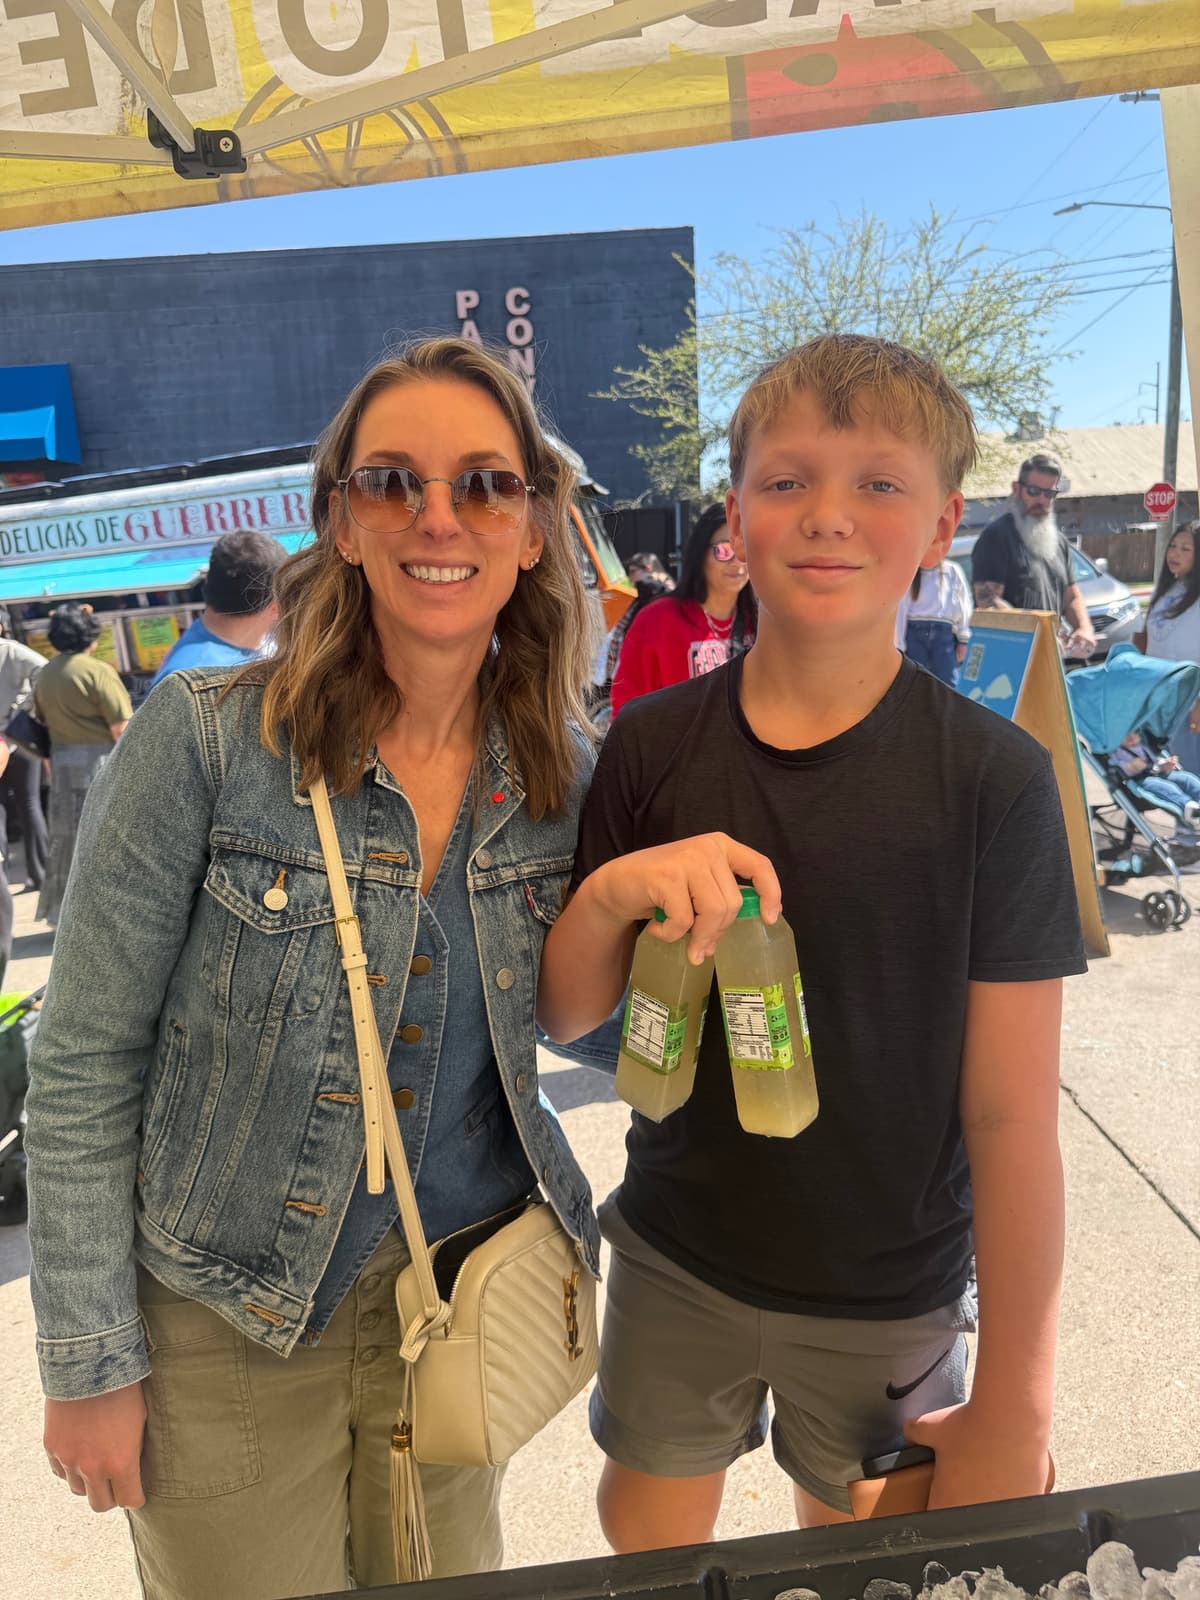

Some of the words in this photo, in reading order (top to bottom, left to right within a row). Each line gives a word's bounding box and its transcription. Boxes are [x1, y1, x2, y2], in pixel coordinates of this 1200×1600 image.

[505, 287, 536, 398] CON
[0, 520, 88, 556] DELICIAS
[95, 516, 123, 543] DE
[124, 492, 308, 544] GUERRER
[1146, 491, 1175, 506] STOP
